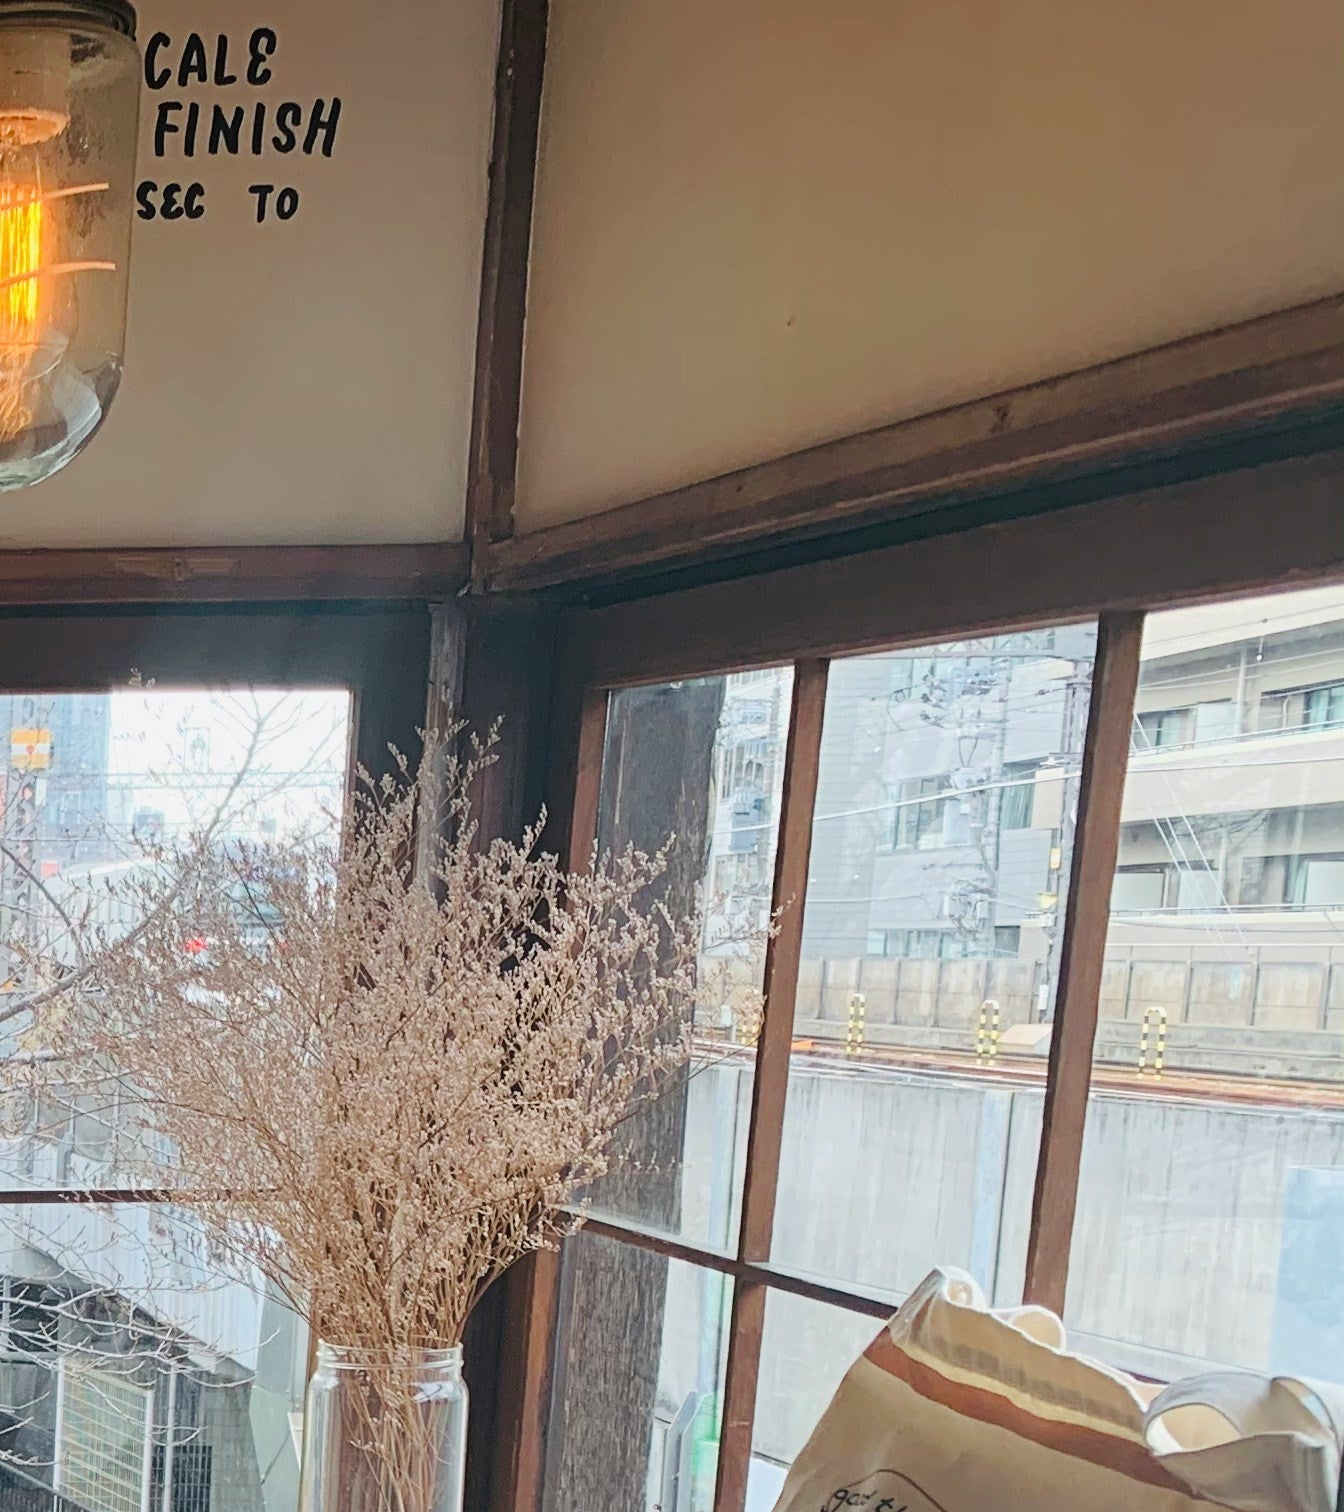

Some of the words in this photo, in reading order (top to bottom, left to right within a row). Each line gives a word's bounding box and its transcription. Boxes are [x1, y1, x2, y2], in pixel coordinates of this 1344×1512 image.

[145, 28, 276, 89] CALE
[155, 98, 341, 157] FINISH
[136, 181, 204, 220] SEC
[249, 185, 298, 223] TO
